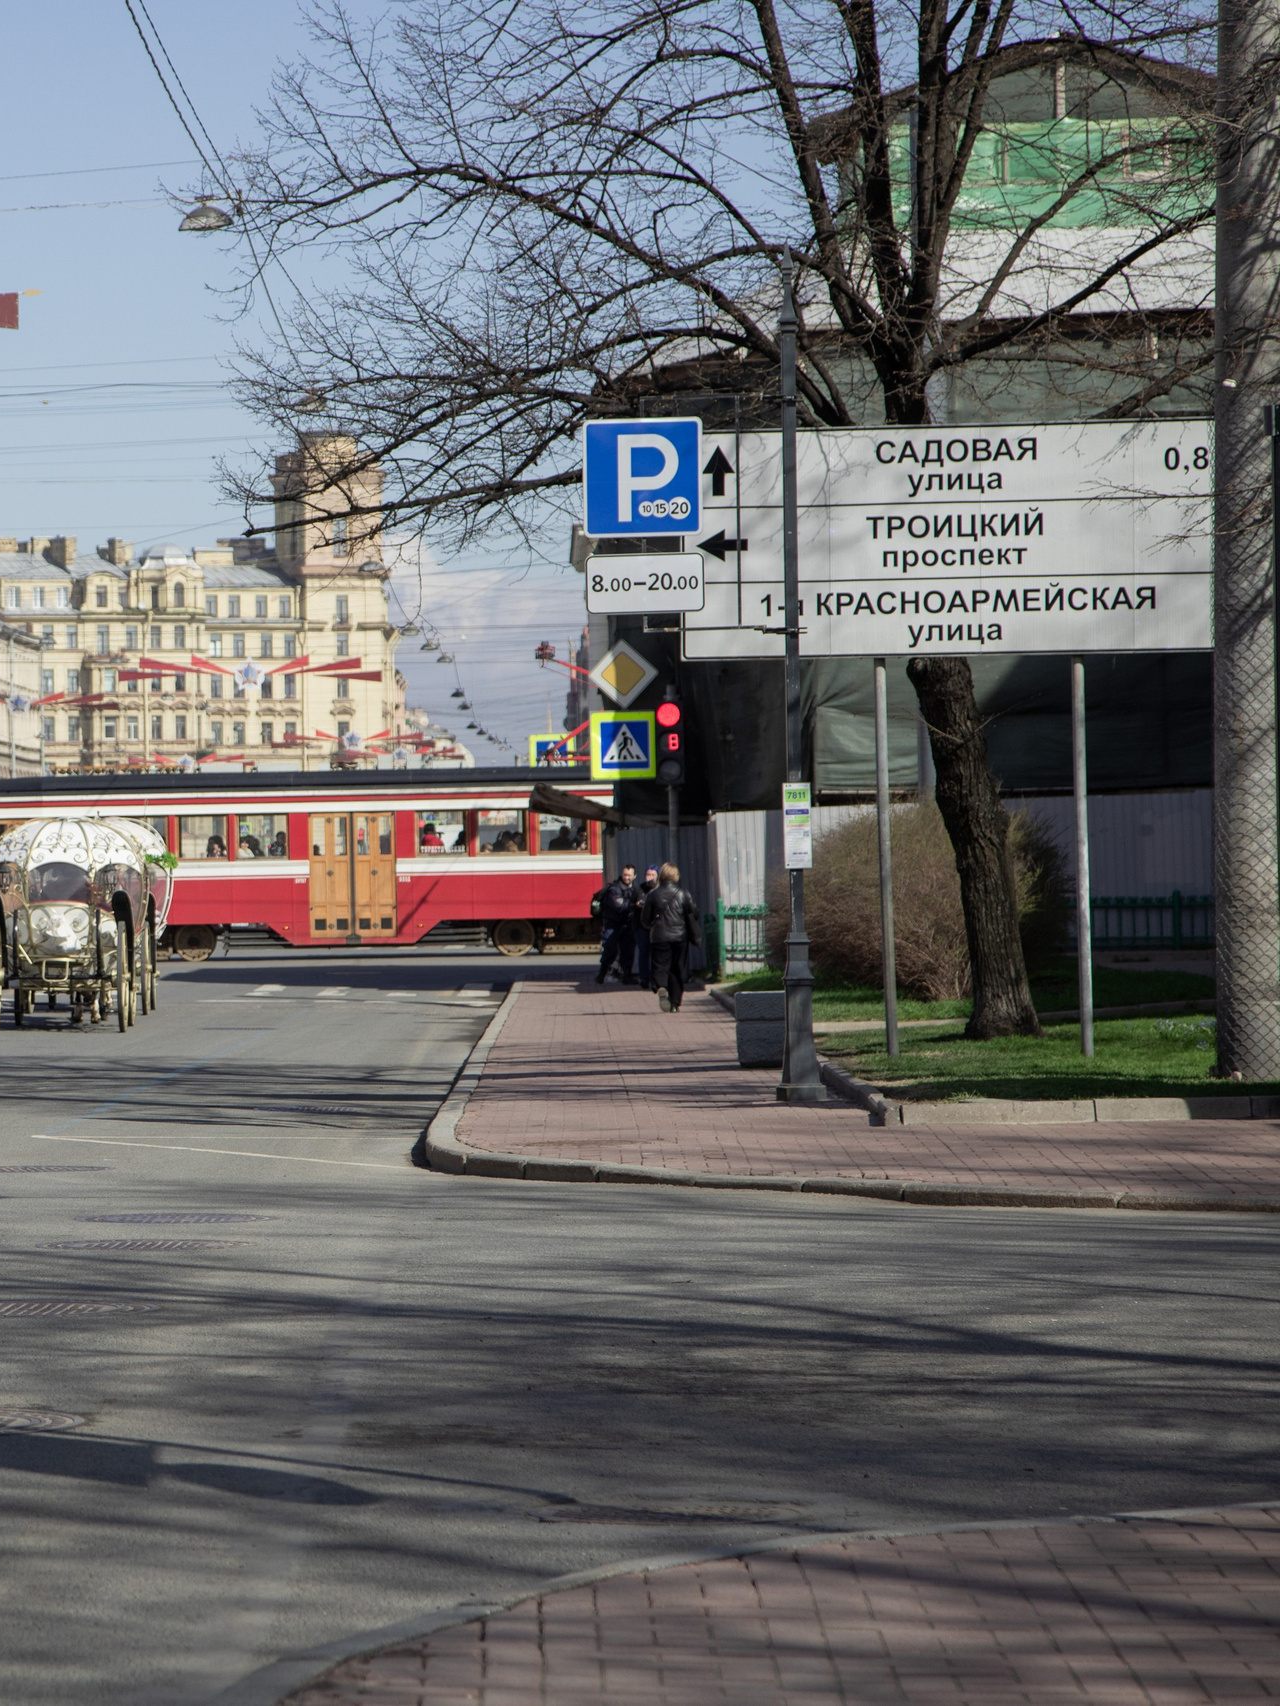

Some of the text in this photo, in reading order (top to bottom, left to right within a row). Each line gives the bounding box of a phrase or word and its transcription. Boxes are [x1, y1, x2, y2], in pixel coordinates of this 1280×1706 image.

[875, 437, 1038, 468] САДОВАЯ
[1164, 446, 1209, 475] 0,8
[617, 433, 679, 522] P
[907, 472, 1003, 498] улица
[641, 501, 689, 515] 10 15 20
[865, 506, 1045, 542] ТРОИЦКИЙ
[882, 547, 1028, 574] проспект
[815, 582, 1157, 617] КРАСНОАРМЕЙСКАЯ
[907, 622, 1003, 649] улица
[668, 733, 679, 751] 8
[786, 791, 806, 799] 7811
